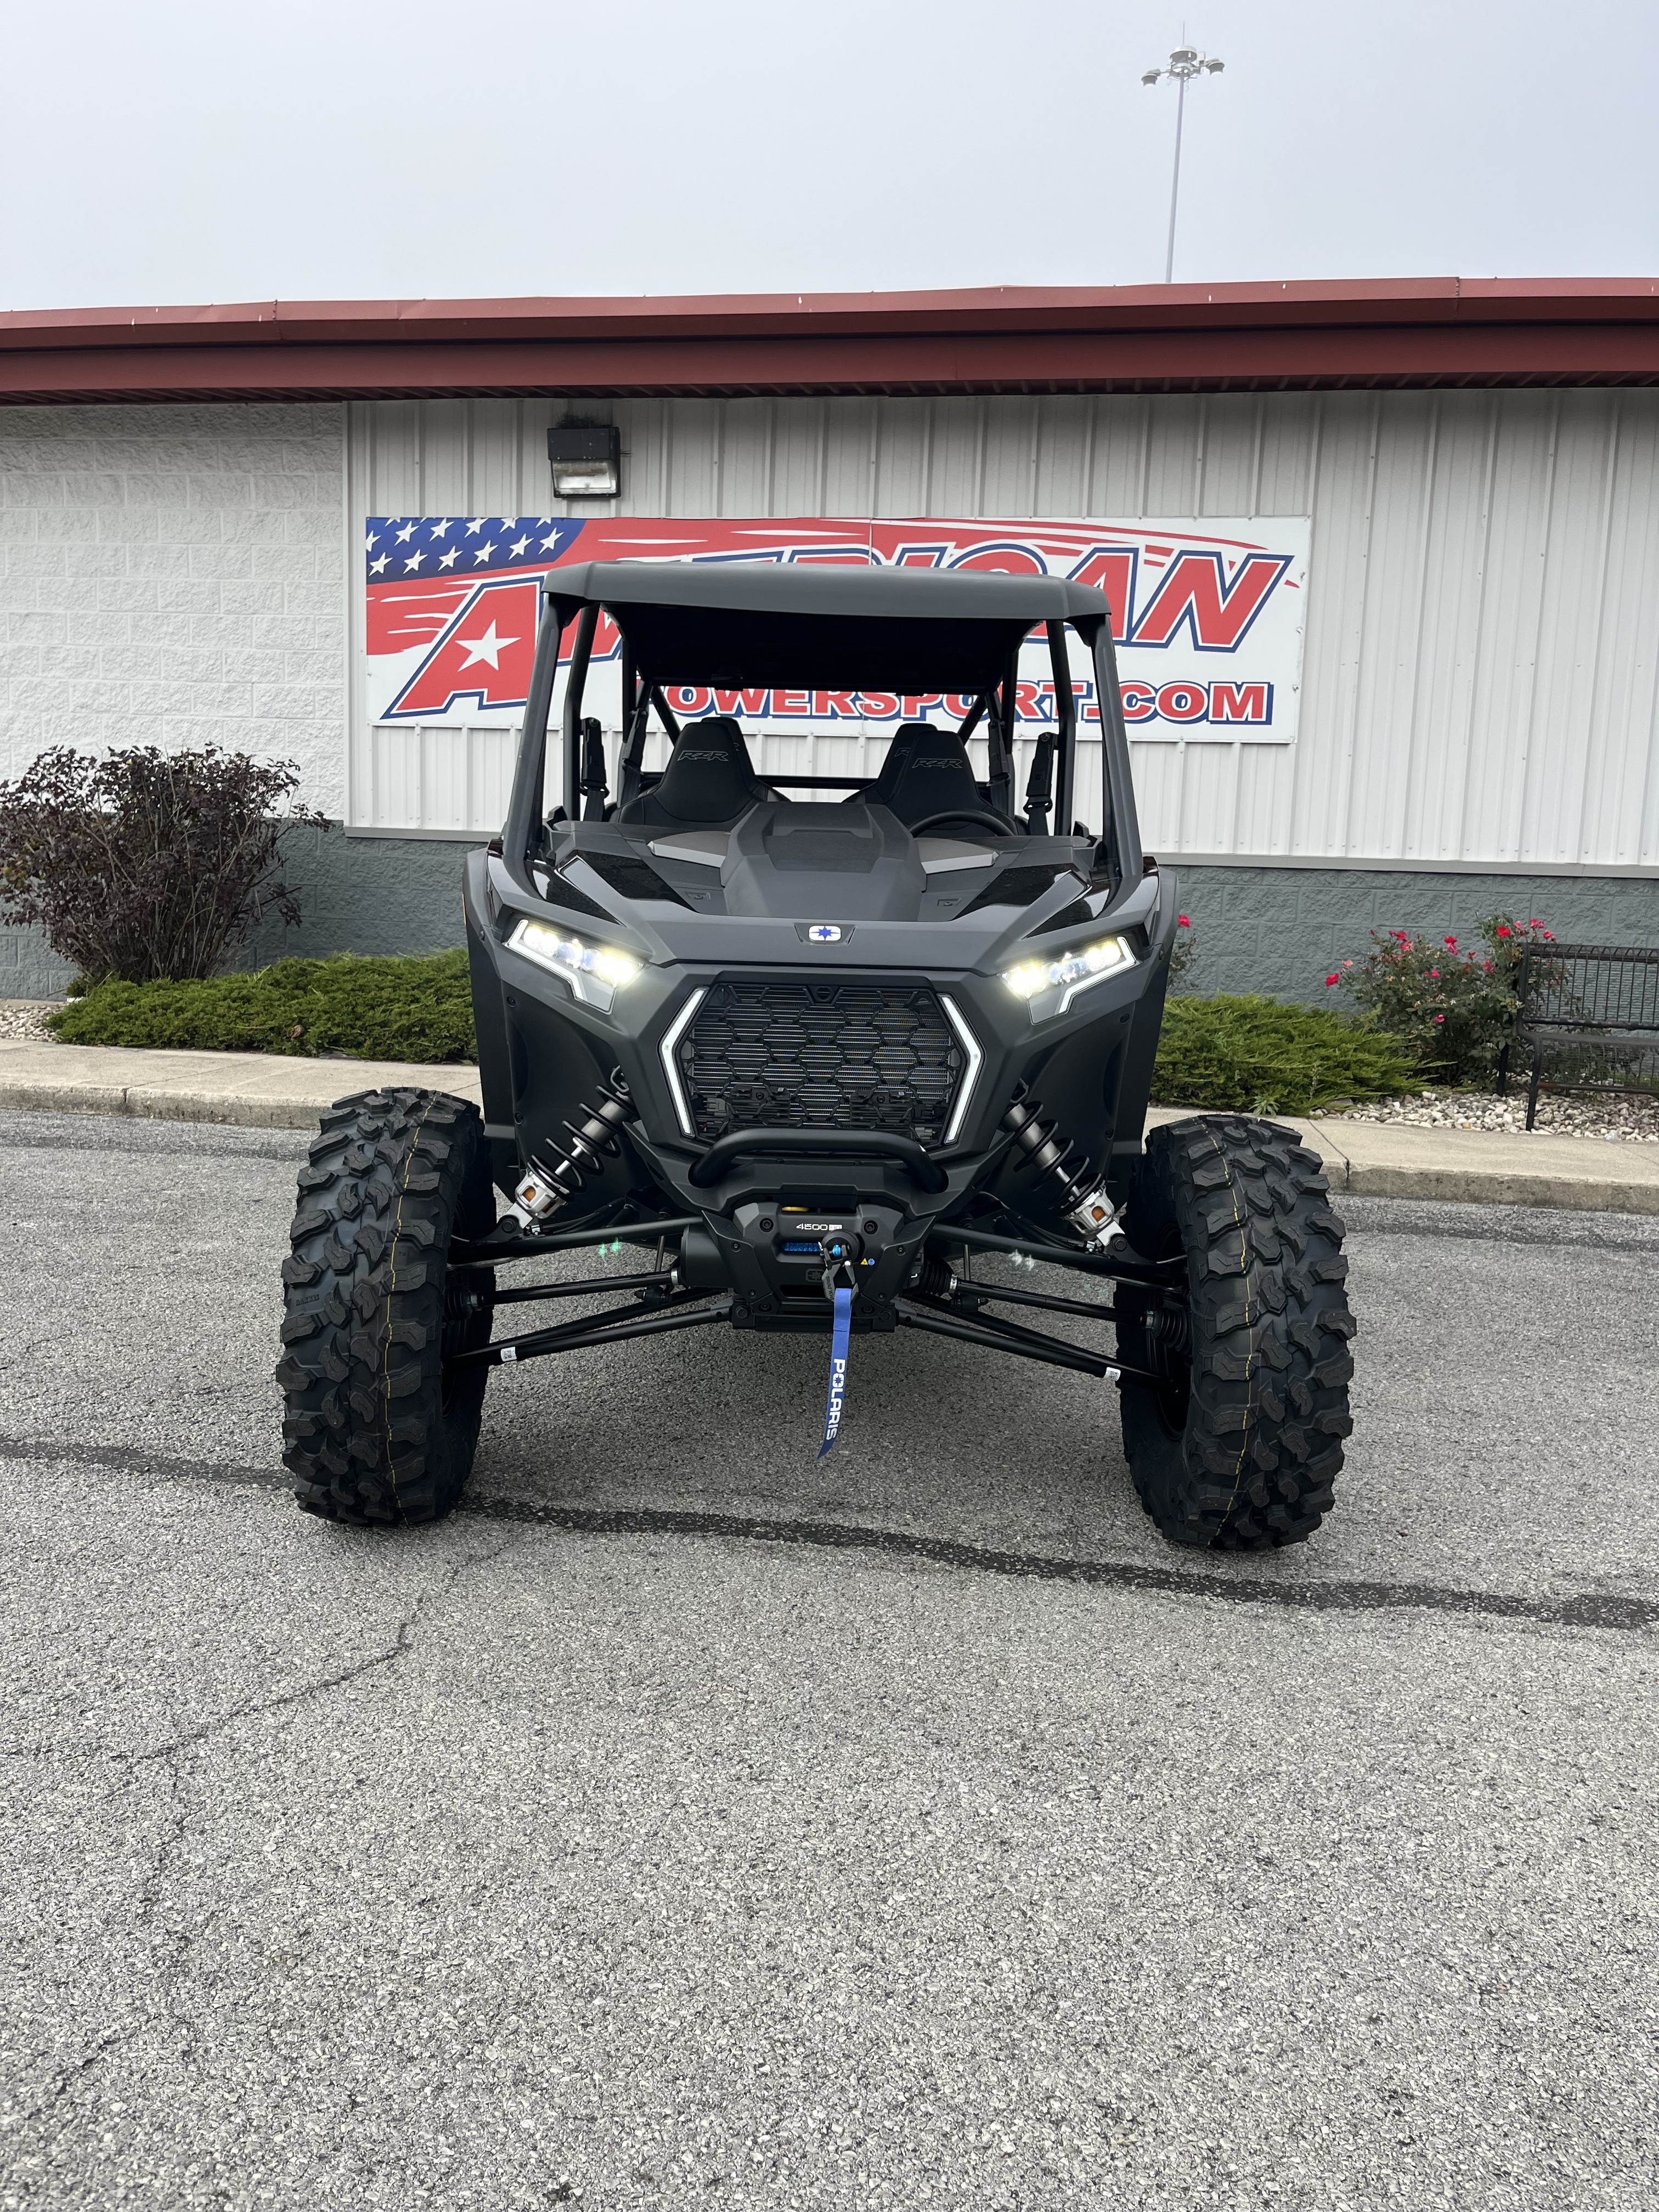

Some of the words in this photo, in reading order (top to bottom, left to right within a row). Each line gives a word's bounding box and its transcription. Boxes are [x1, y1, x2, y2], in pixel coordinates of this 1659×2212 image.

[636, 680, 1274, 725] OWERSPORT.COM
[678, 750, 729, 761] RZR
[912, 758, 963, 769] RZR
[826, 1358, 846, 1441] POLARIS
